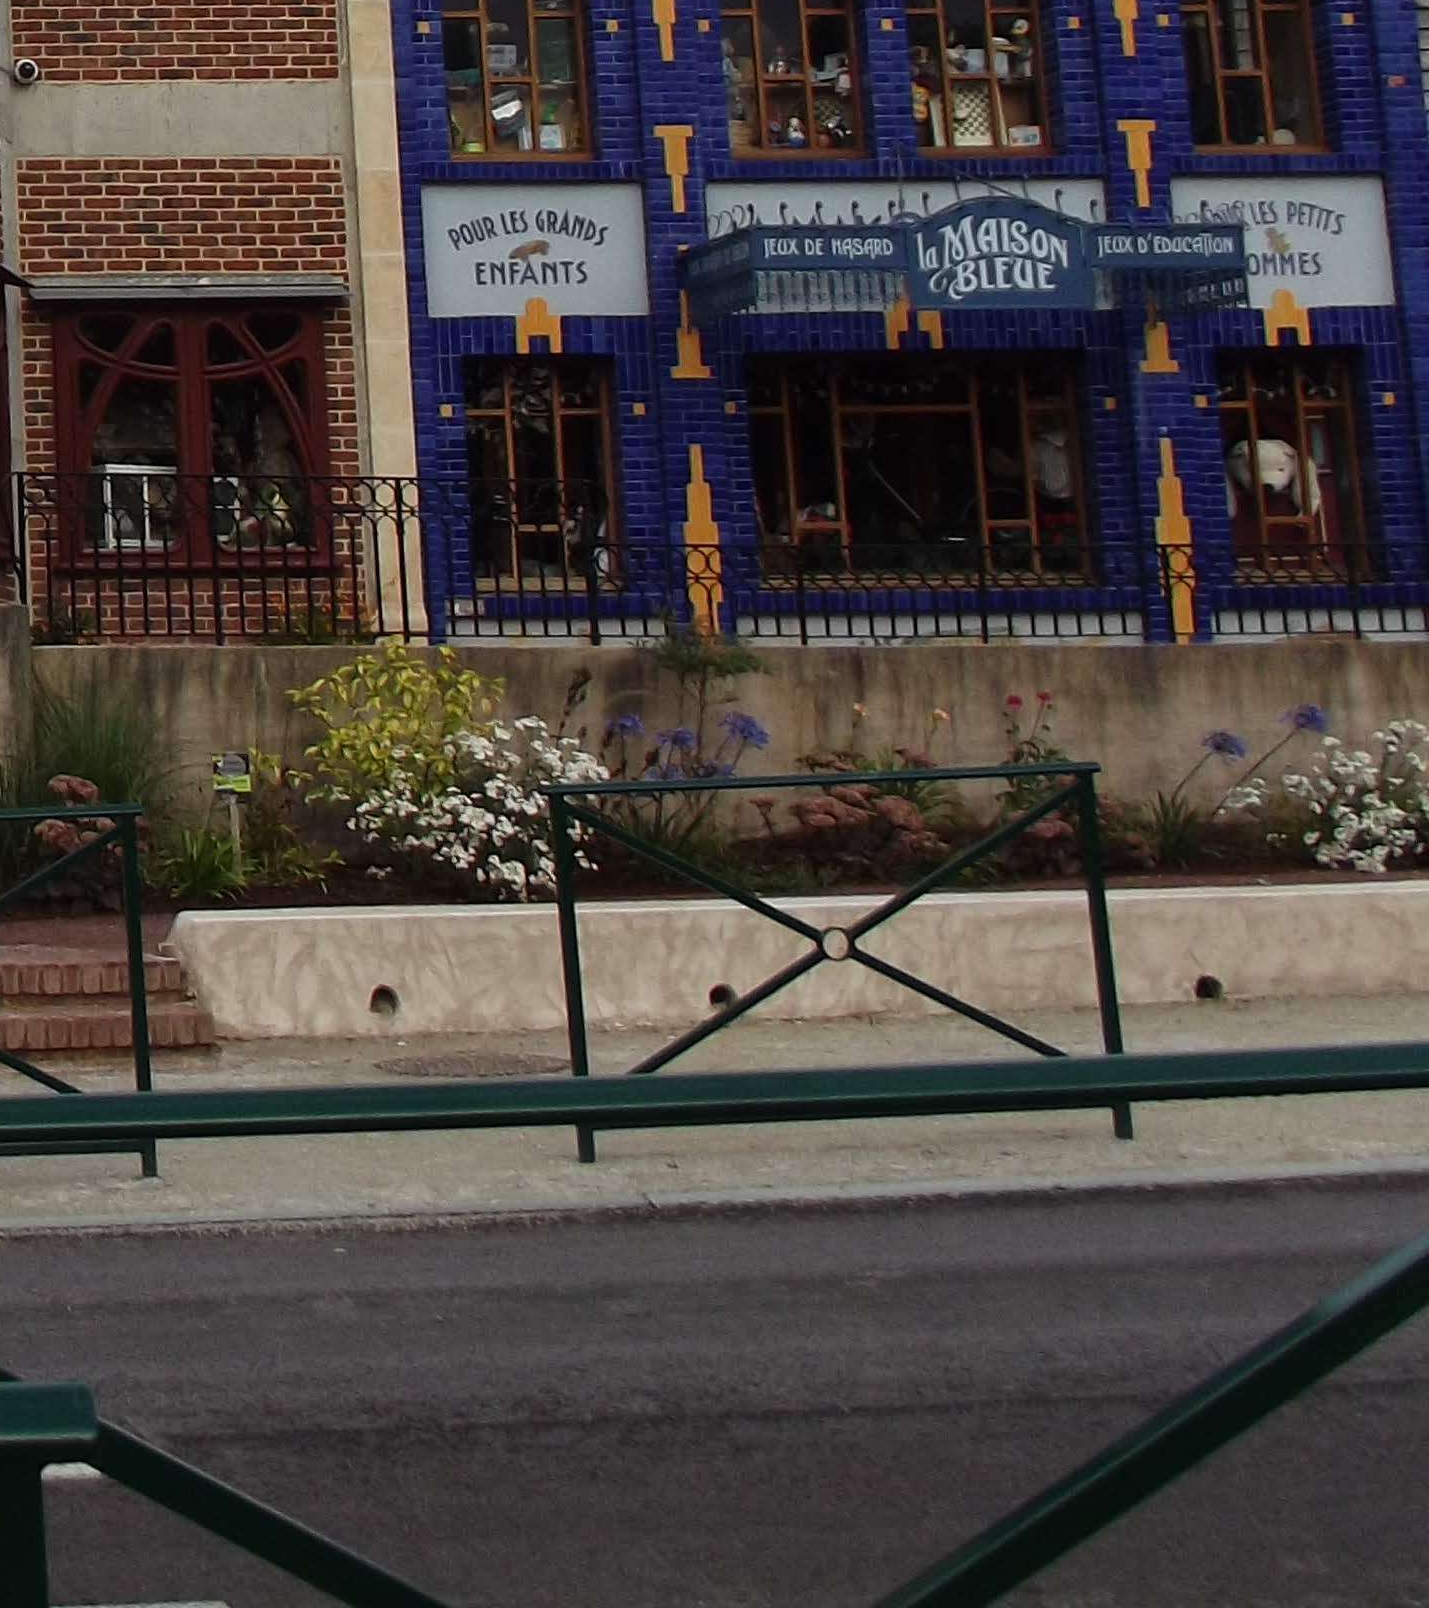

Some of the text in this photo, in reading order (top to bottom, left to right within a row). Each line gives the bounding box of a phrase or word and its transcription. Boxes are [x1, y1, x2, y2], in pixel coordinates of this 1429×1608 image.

[447, 207, 610, 251] POUR LES GRANDS
[1249, 201, 1278, 225] LES
[1287, 200, 1347, 236] PETITS
[764, 238, 799, 259] JEUX
[805, 239, 824, 256] DE
[930, 215, 1069, 290] MAISON
[1097, 233, 1234, 258] JEUX D'EDUCATION
[475, 260, 588, 285] ENFANTS
[948, 256, 1055, 300] BLEUE
[1245, 253, 1323, 276] OMMES
